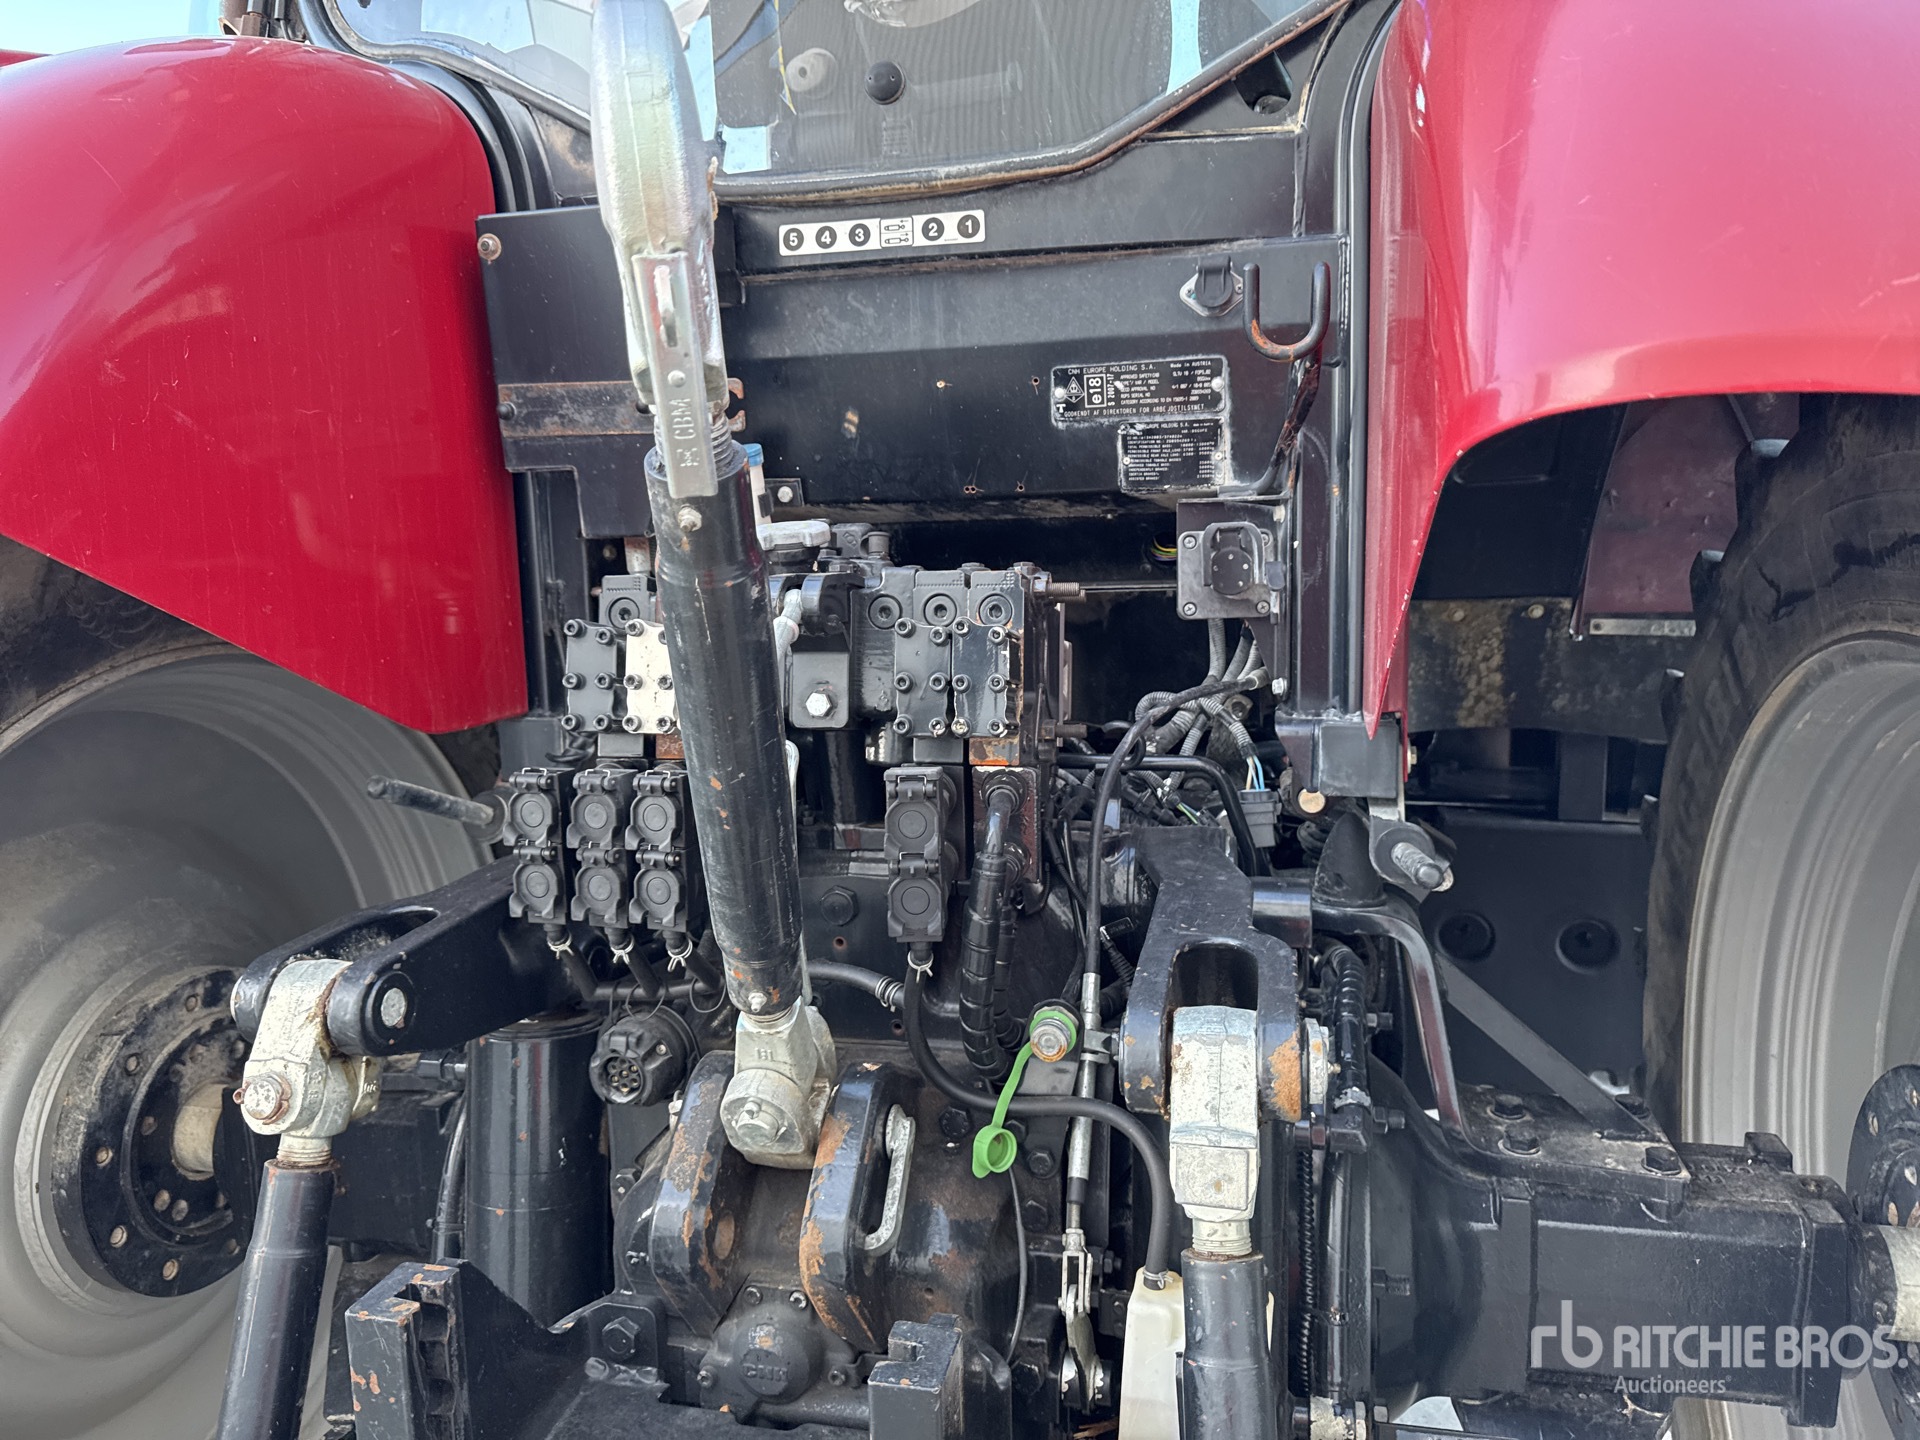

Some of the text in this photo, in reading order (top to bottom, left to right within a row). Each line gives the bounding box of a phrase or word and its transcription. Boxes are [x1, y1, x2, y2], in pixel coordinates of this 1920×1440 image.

[788, 232, 799, 247] 5
[820, 230, 832, 245] 4
[854, 228, 865, 242] 3
[928, 222, 939, 237] 2
[1088, 377, 1102, 404] e18
[669, 398, 696, 439] CBM
